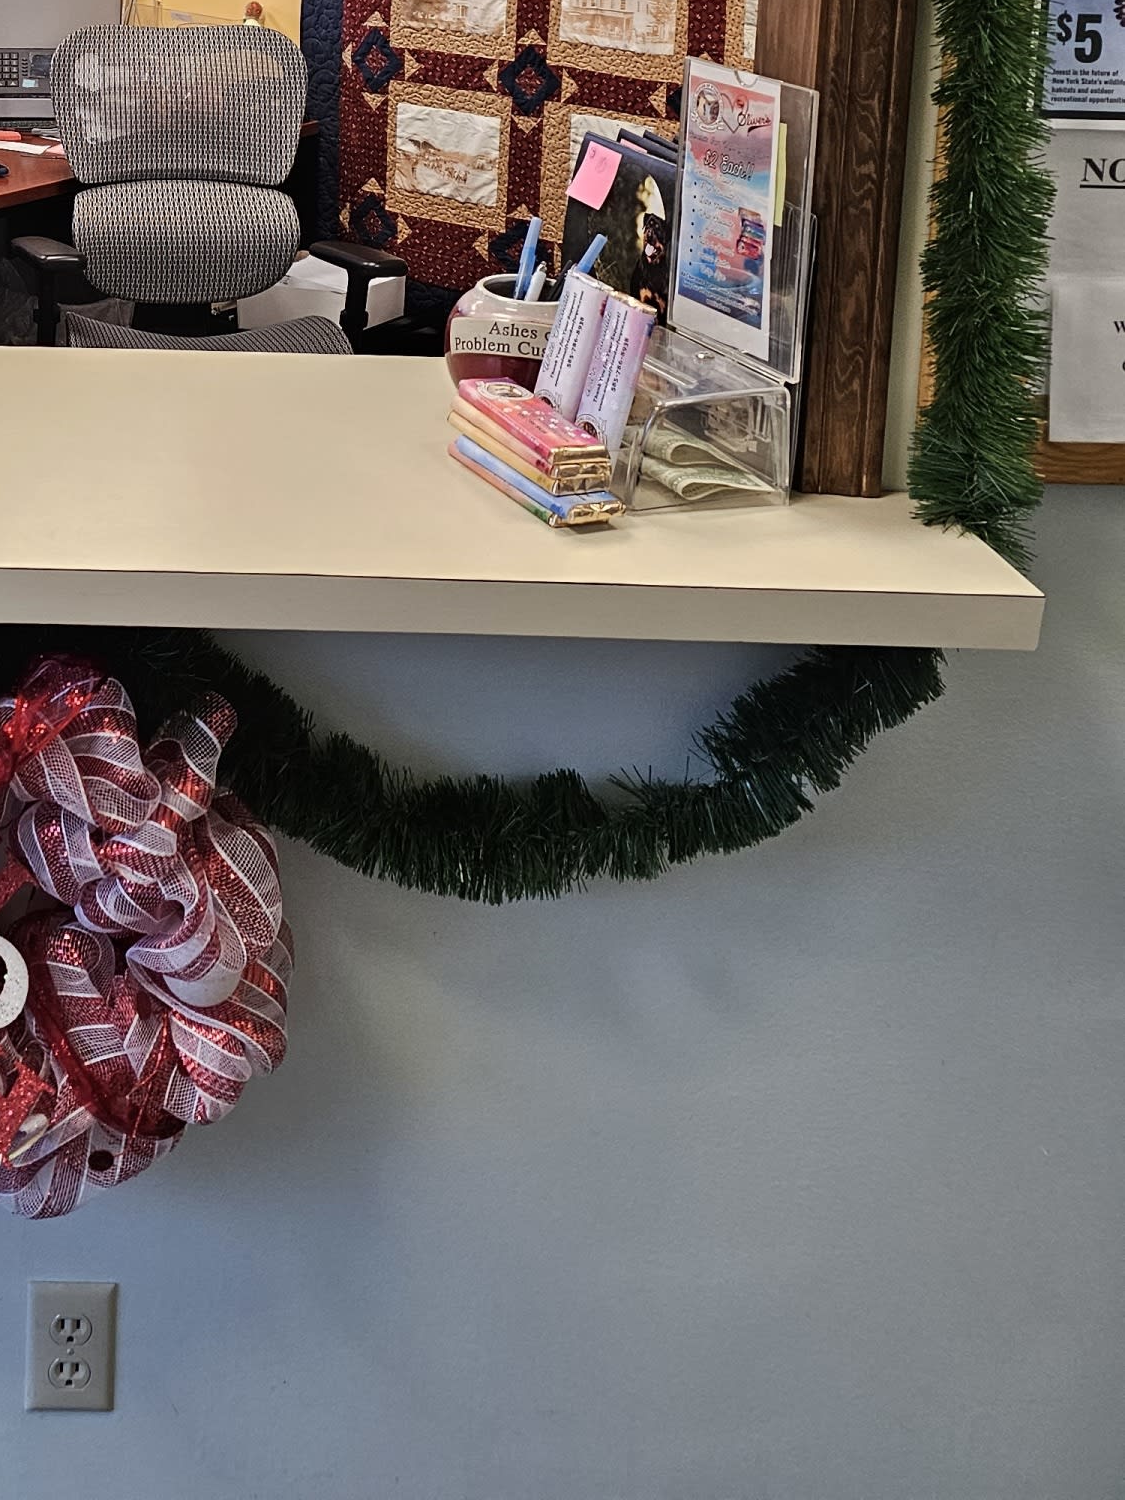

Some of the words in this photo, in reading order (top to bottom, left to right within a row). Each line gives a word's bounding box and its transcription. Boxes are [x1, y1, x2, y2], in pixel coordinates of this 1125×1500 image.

[1056, 9, 1103, 63] $5
[703, 148, 718, 170] $2
[489, 321, 538, 340] Ashes
[455, 337, 511, 353] Problem
